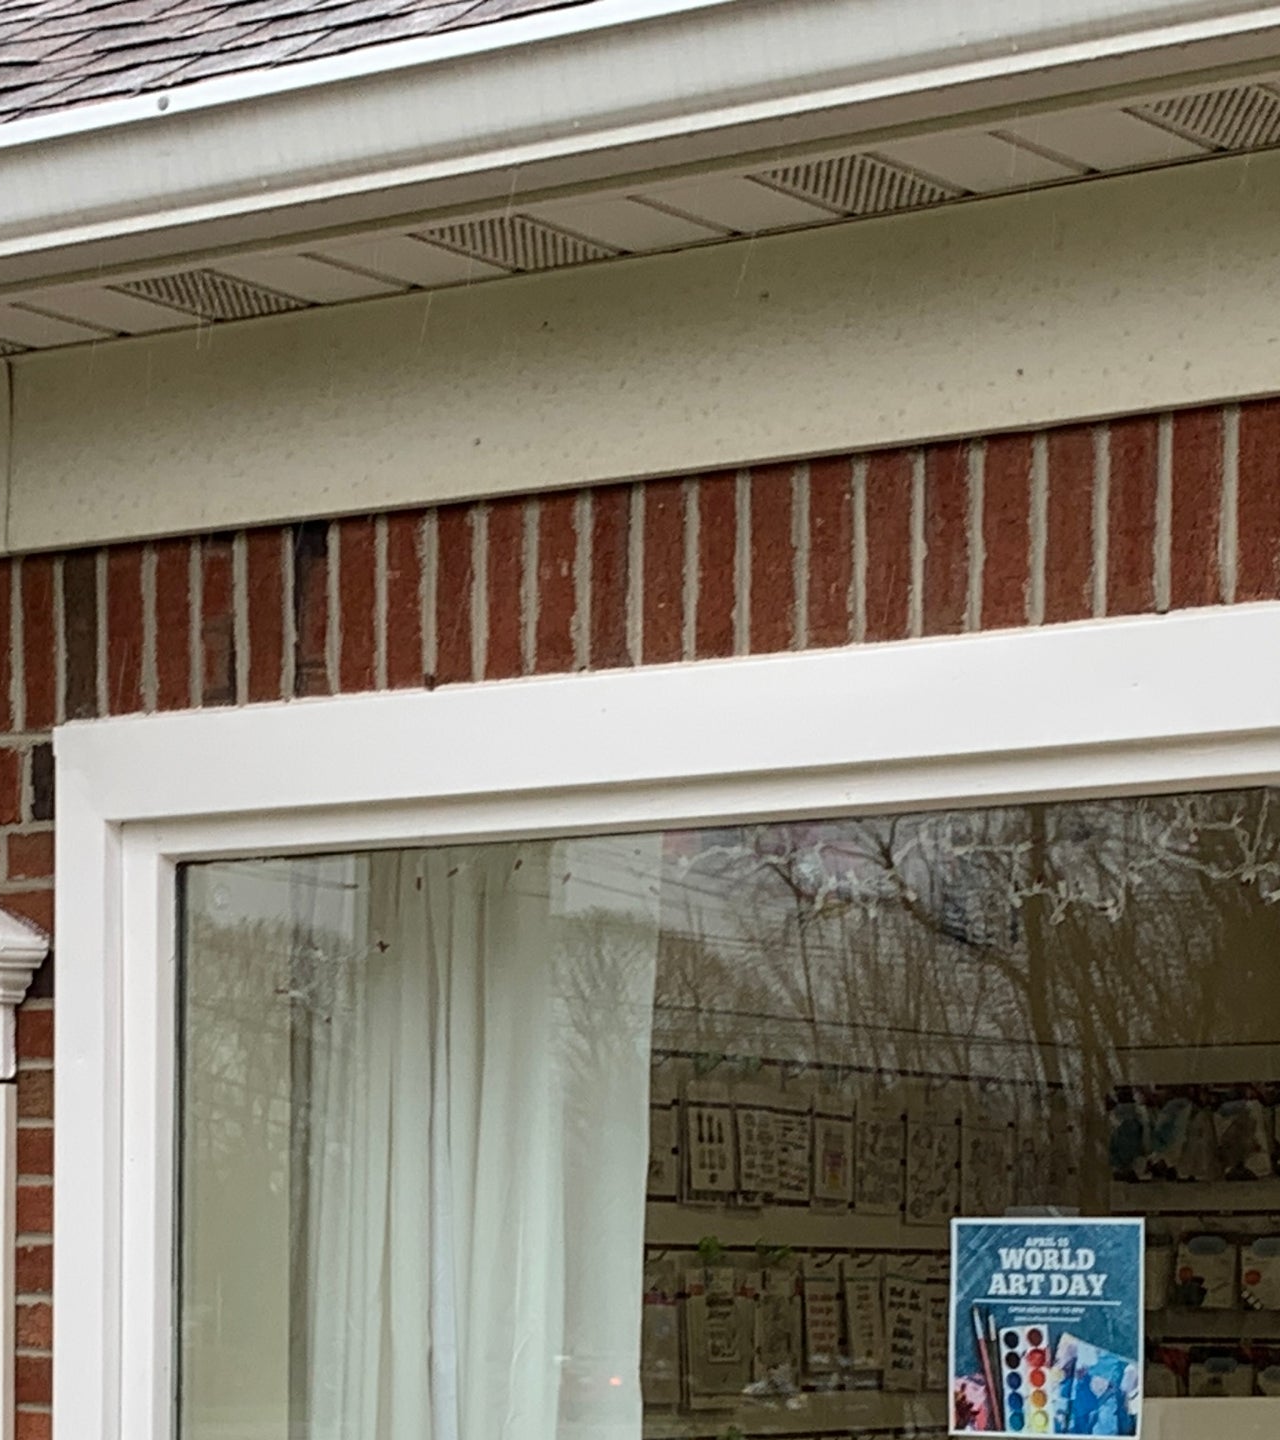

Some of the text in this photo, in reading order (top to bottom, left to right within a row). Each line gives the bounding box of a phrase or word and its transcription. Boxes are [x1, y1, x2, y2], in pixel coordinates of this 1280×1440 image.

[998, 1248, 1096, 1271] WORLD
[987, 1273, 1108, 1297] ART DAY
